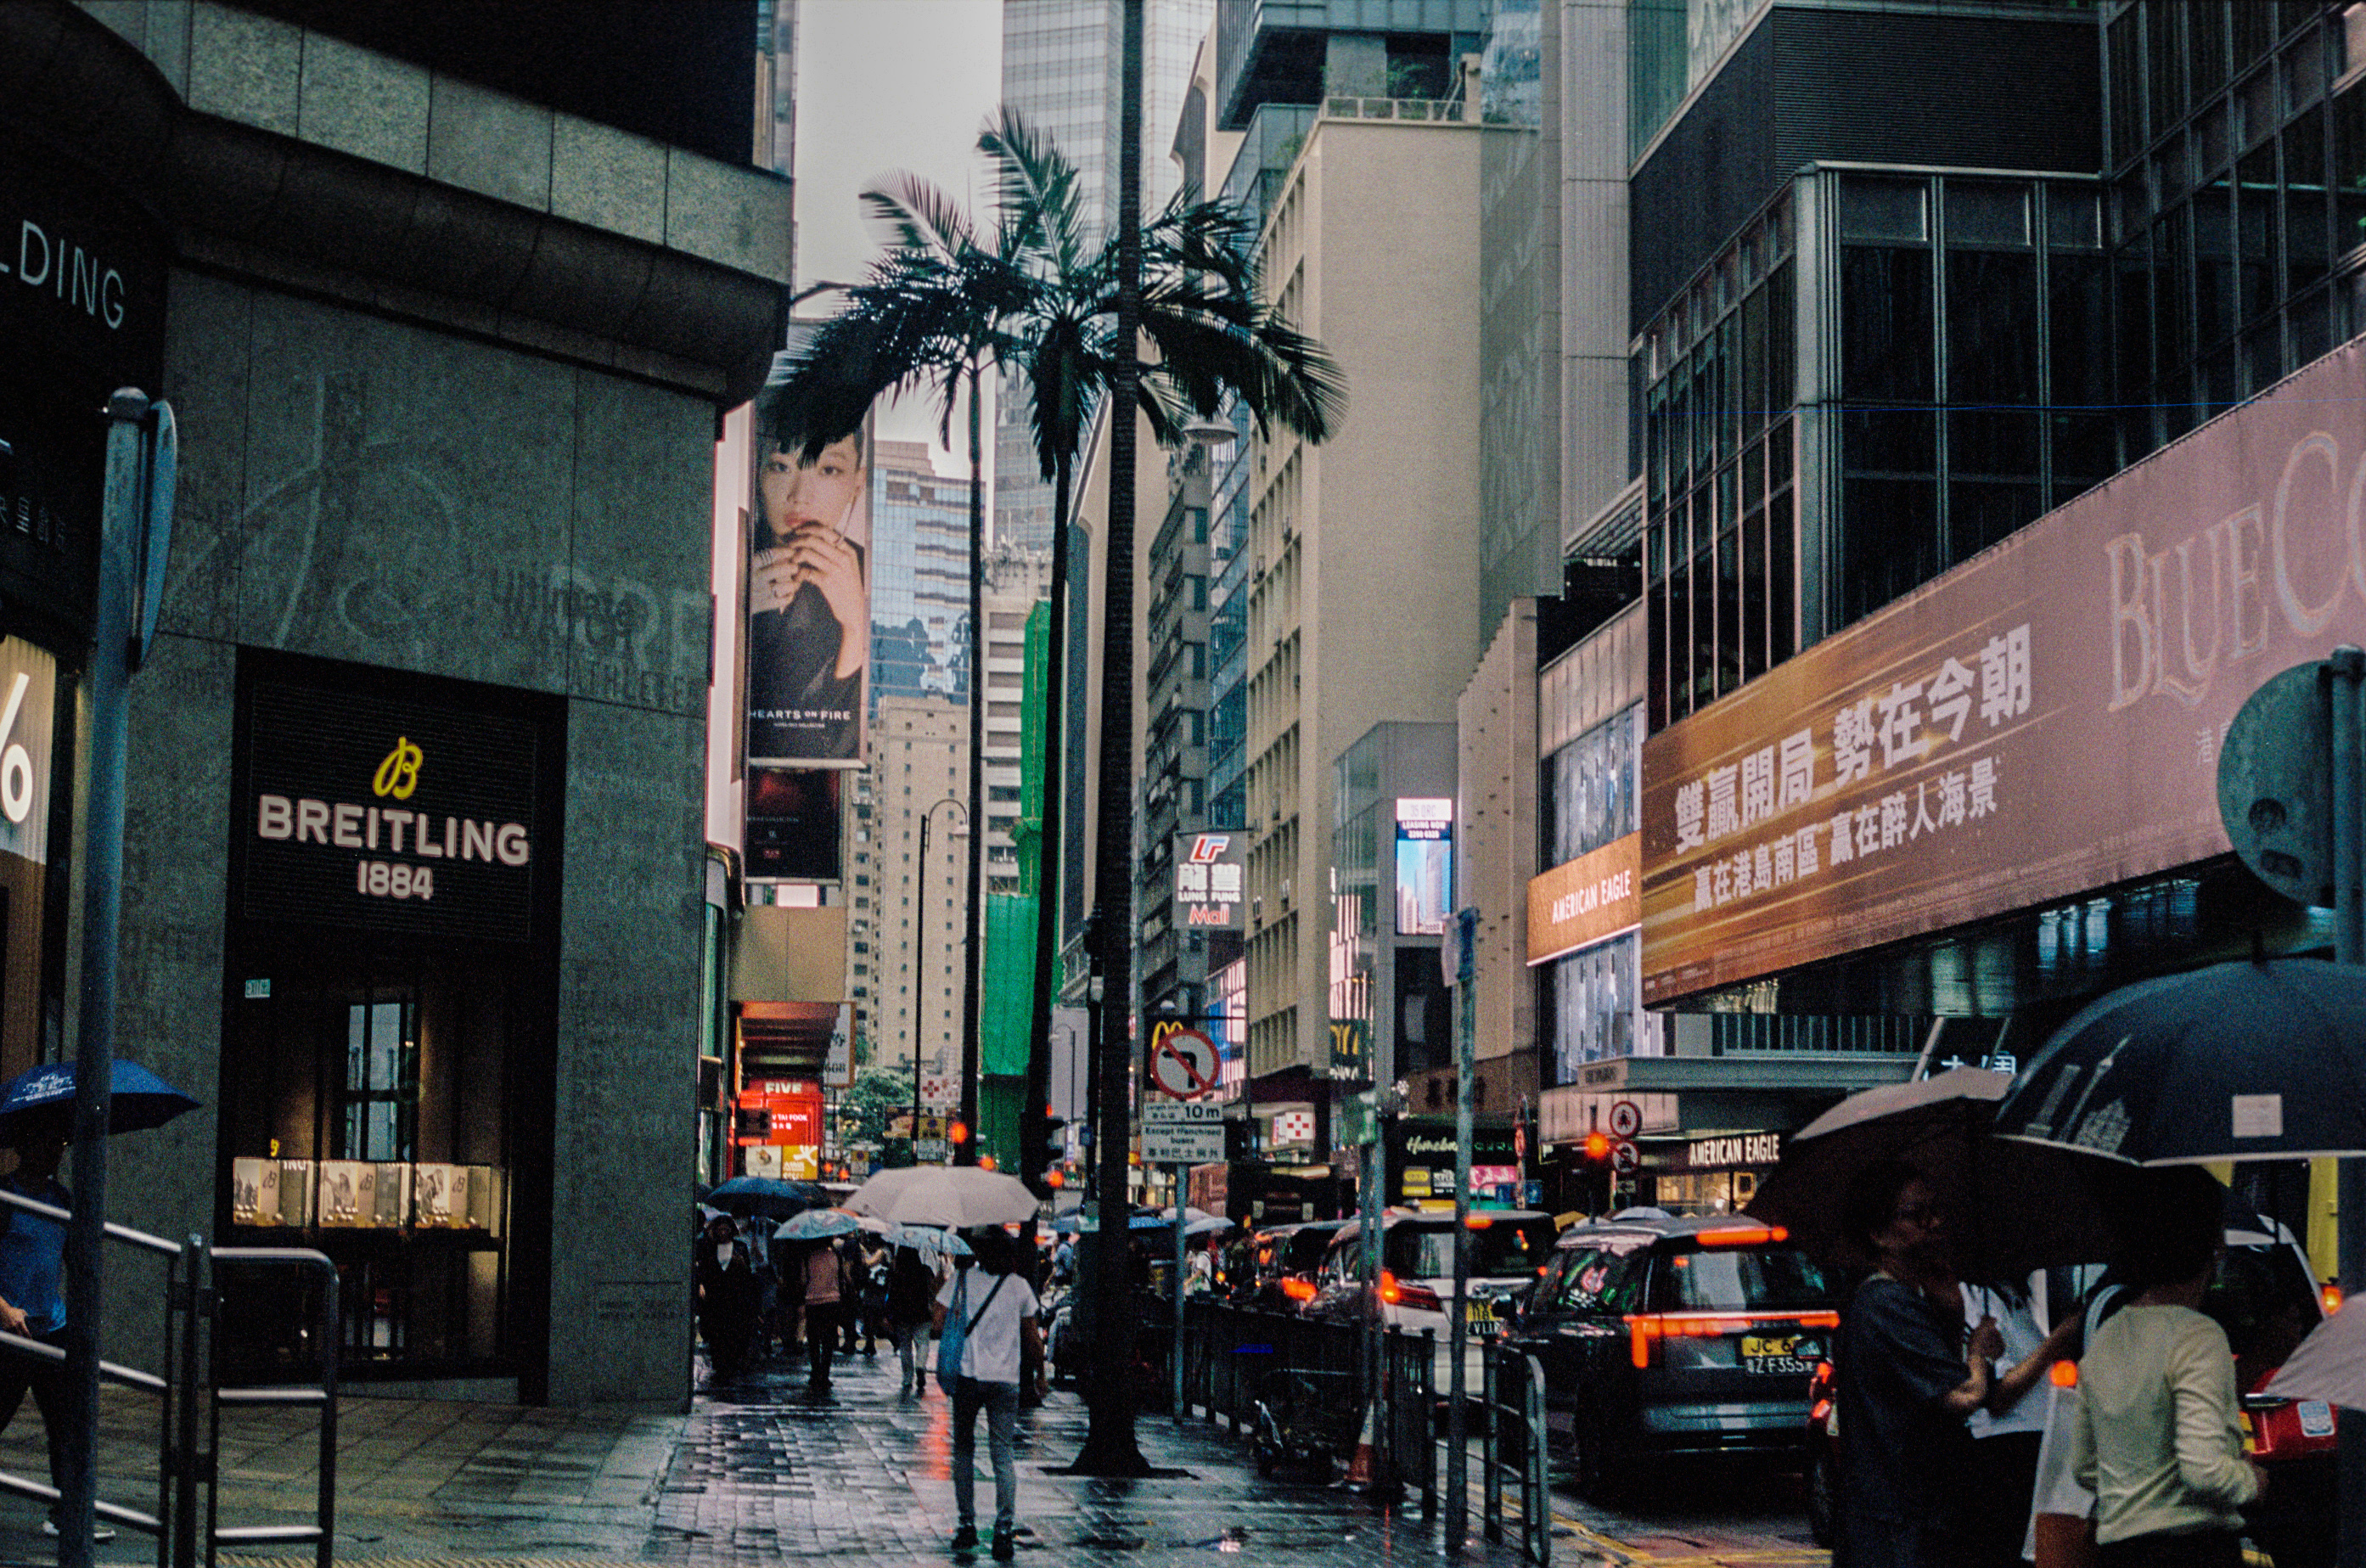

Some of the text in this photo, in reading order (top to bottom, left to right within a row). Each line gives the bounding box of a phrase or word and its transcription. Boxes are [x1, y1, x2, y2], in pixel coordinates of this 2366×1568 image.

[0, 220, 124, 329] DING
[820, 711, 851, 721] FIRE
[1832, 622, 2032, 789] 勢在今朝
[258, 794, 531, 867] BREITLING
[1402, 820, 1446, 829] LEASING NOW
[358, 860, 434, 900] 1884
[1177, 891, 1240, 902] LUNG FUNG
[1552, 869, 1631, 925] AMERICAN EAGLE
[1189, 903, 1229, 925] Mall
[765, 1082, 802, 1094] FIVE
[1185, 1104, 1203, 1118] 10
[1205, 1108, 1220, 1118] m
[1145, 1126, 1174, 1136] Except
[1689, 1133, 1780, 1166] AMERICAN EAGLE
